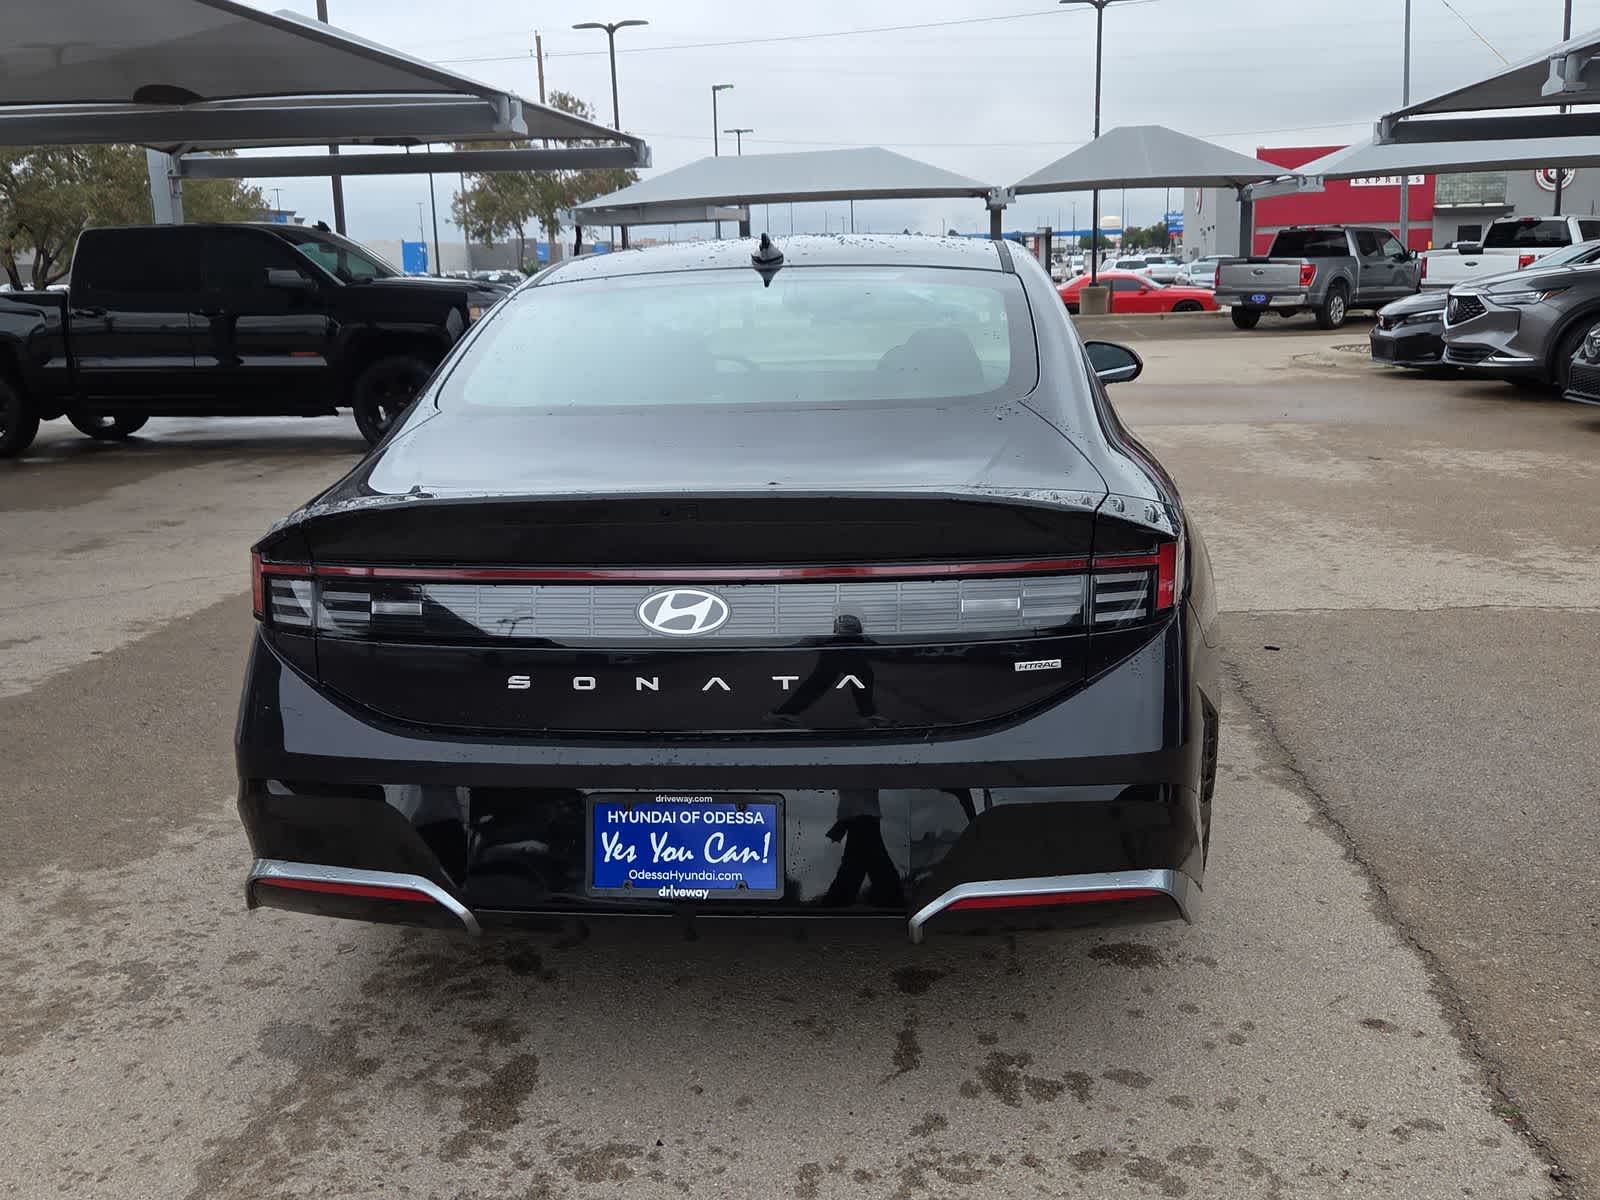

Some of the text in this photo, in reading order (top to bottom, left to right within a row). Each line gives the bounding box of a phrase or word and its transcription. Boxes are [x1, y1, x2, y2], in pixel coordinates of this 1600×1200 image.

[1354, 175, 1421, 184] EXPRES
[1017, 660, 1060, 670] HTRAC
[507, 674, 867, 692] SONATA
[655, 794, 713, 804] driveway.com
[607, 811, 765, 825] HYUNDAI OF ODESSA
[601, 831, 771, 864] Yes You Can!
[628, 869, 743, 881] OdessaHyundai.com
[658, 885, 710, 899] driveway
